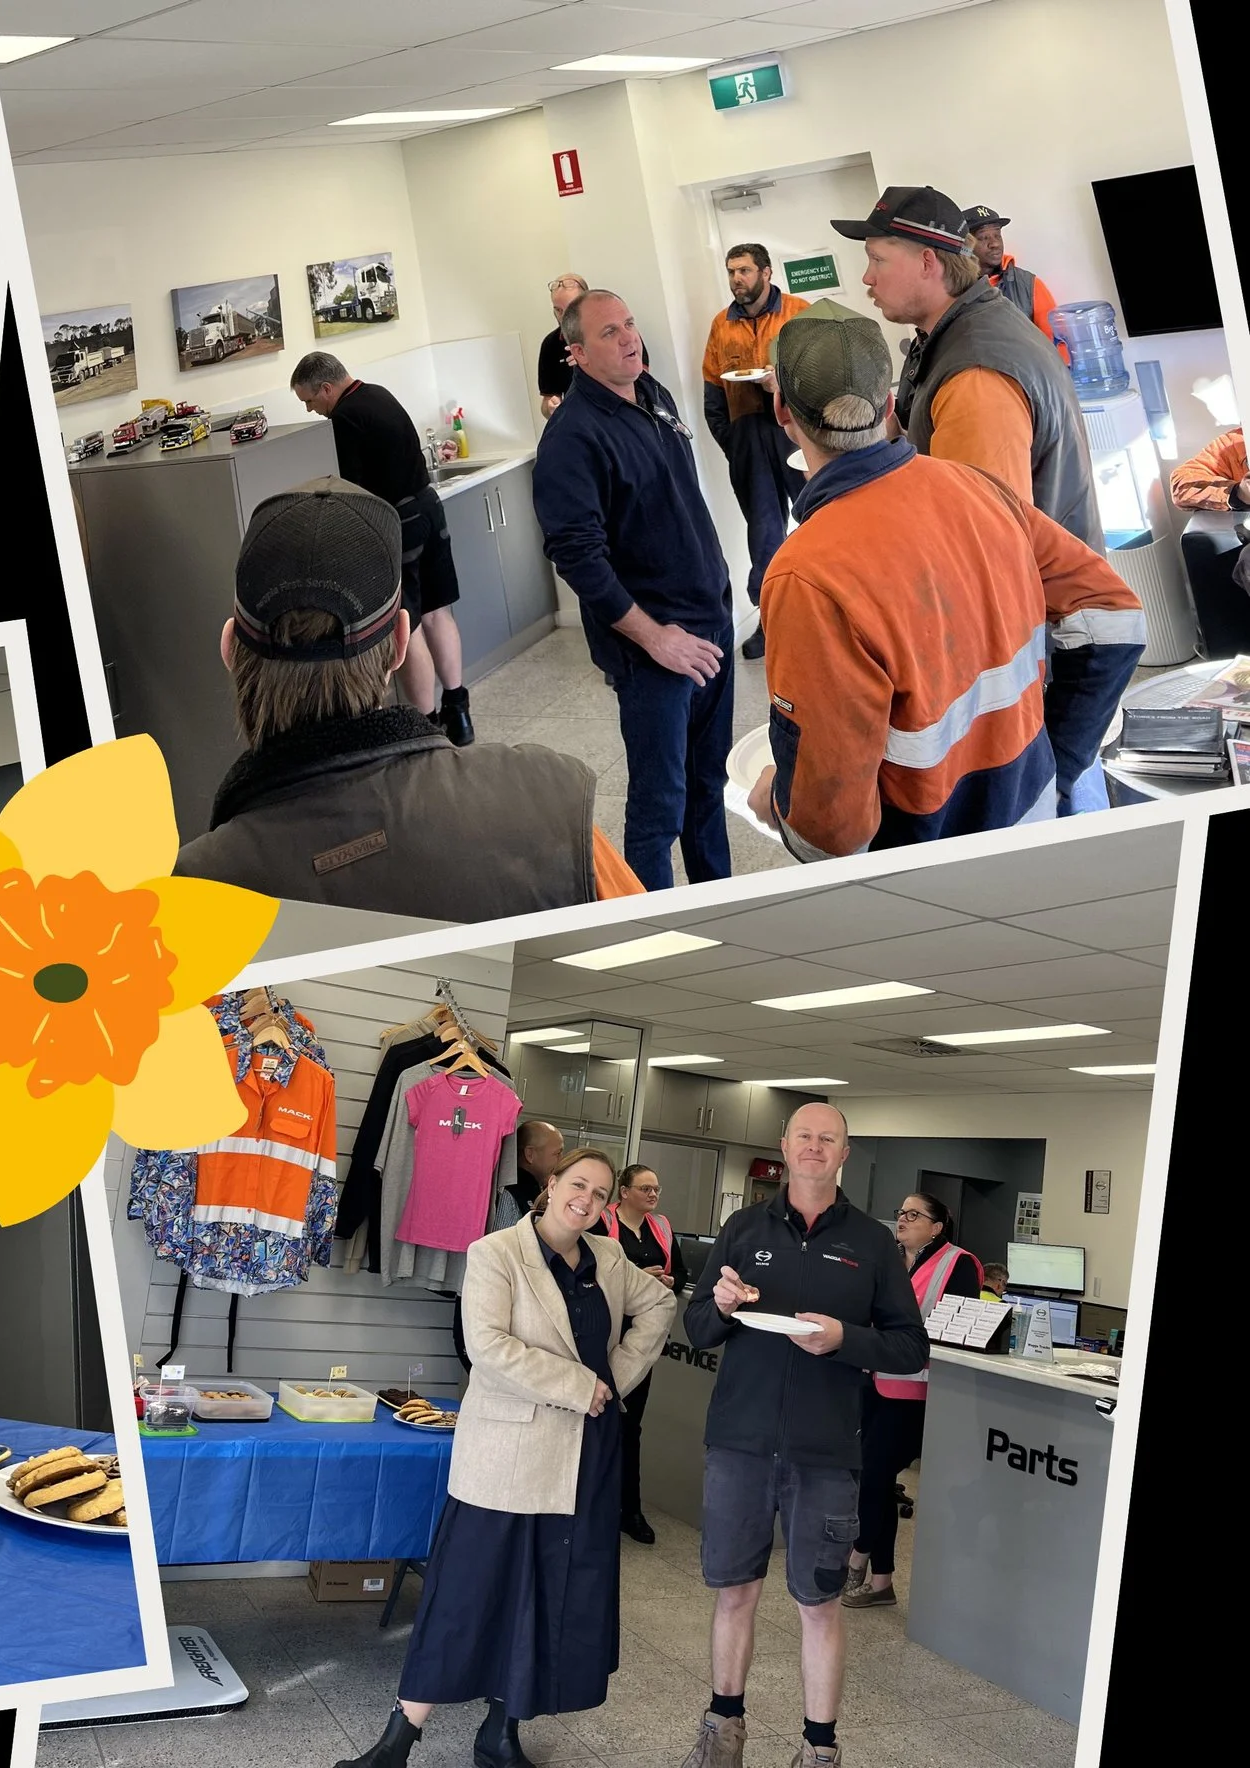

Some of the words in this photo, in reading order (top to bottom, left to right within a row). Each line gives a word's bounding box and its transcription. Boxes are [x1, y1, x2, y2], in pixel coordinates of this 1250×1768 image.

[790, 267, 820, 277] EMERGENCY
[799, 276, 809, 284] NOT
[808, 272, 833, 282] OBSTRUCT
[278, 1106, 314, 1121] MACK
[439, 1119, 482, 1130] MCK
[986, 1427, 1079, 1487] Parts
[178, 1636, 223, 1686] FREIGHTER
